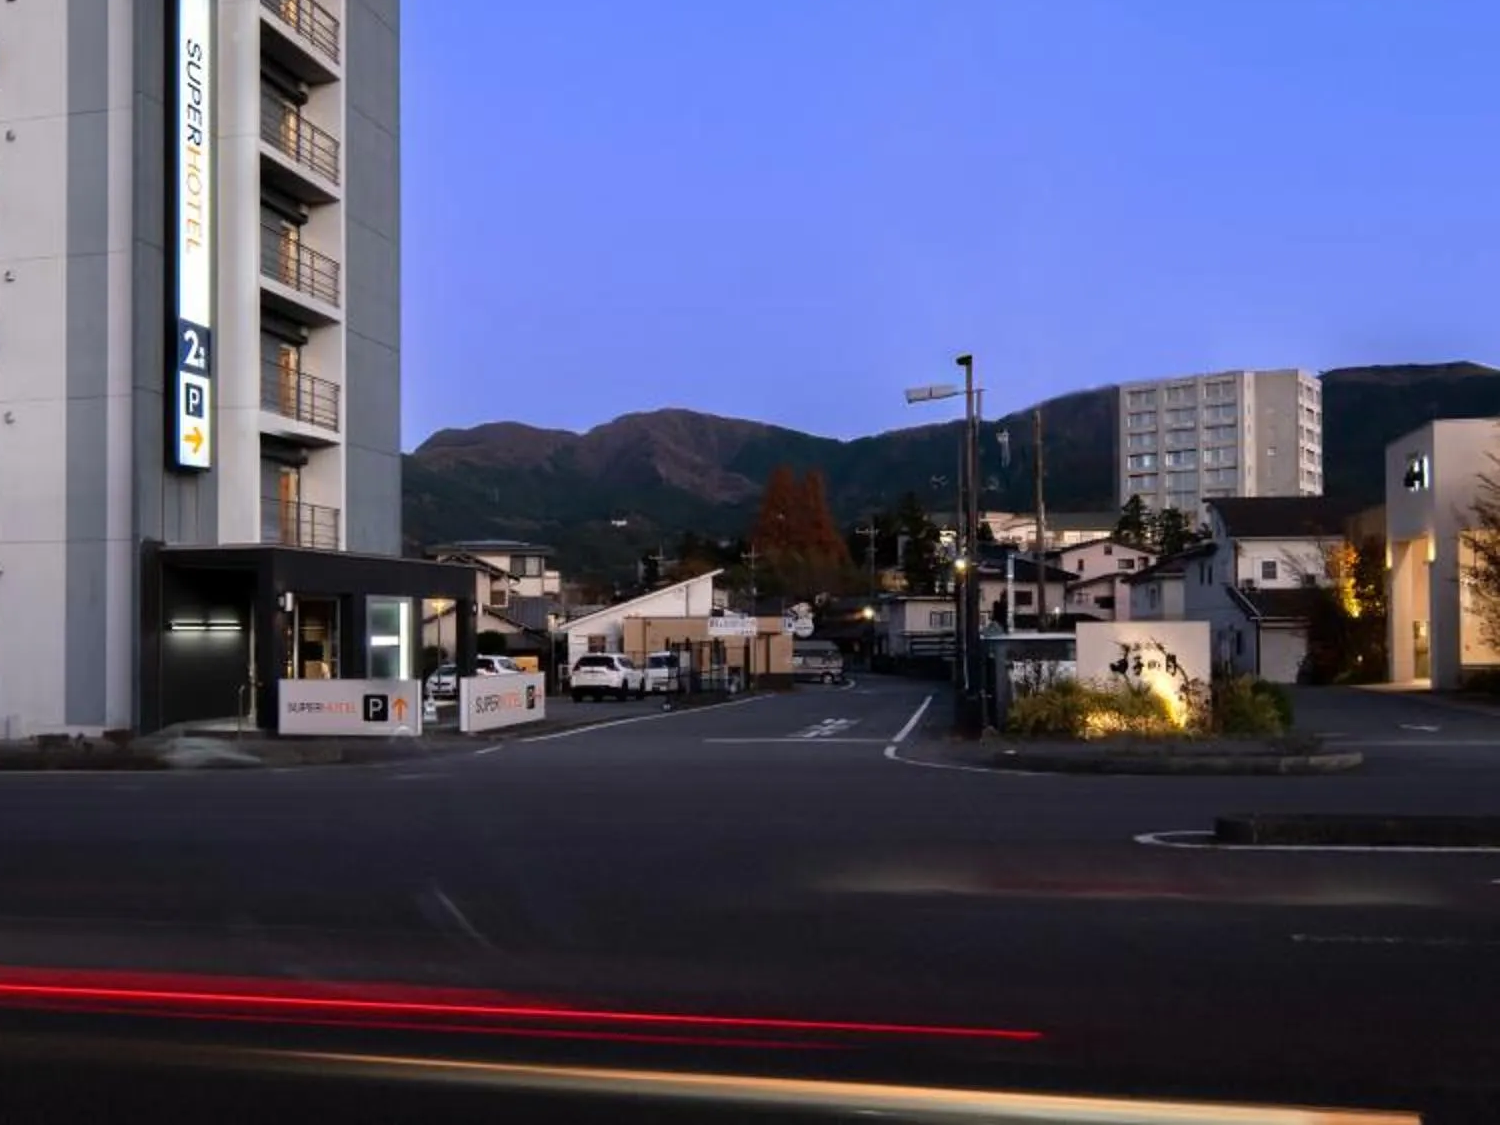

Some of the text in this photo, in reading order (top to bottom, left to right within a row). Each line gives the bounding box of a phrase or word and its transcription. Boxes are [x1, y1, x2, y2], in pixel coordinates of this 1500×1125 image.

[186, 38, 203, 253] SUPERHOTEL
[189, 388, 200, 413] P
[368, 698, 384, 720] P
